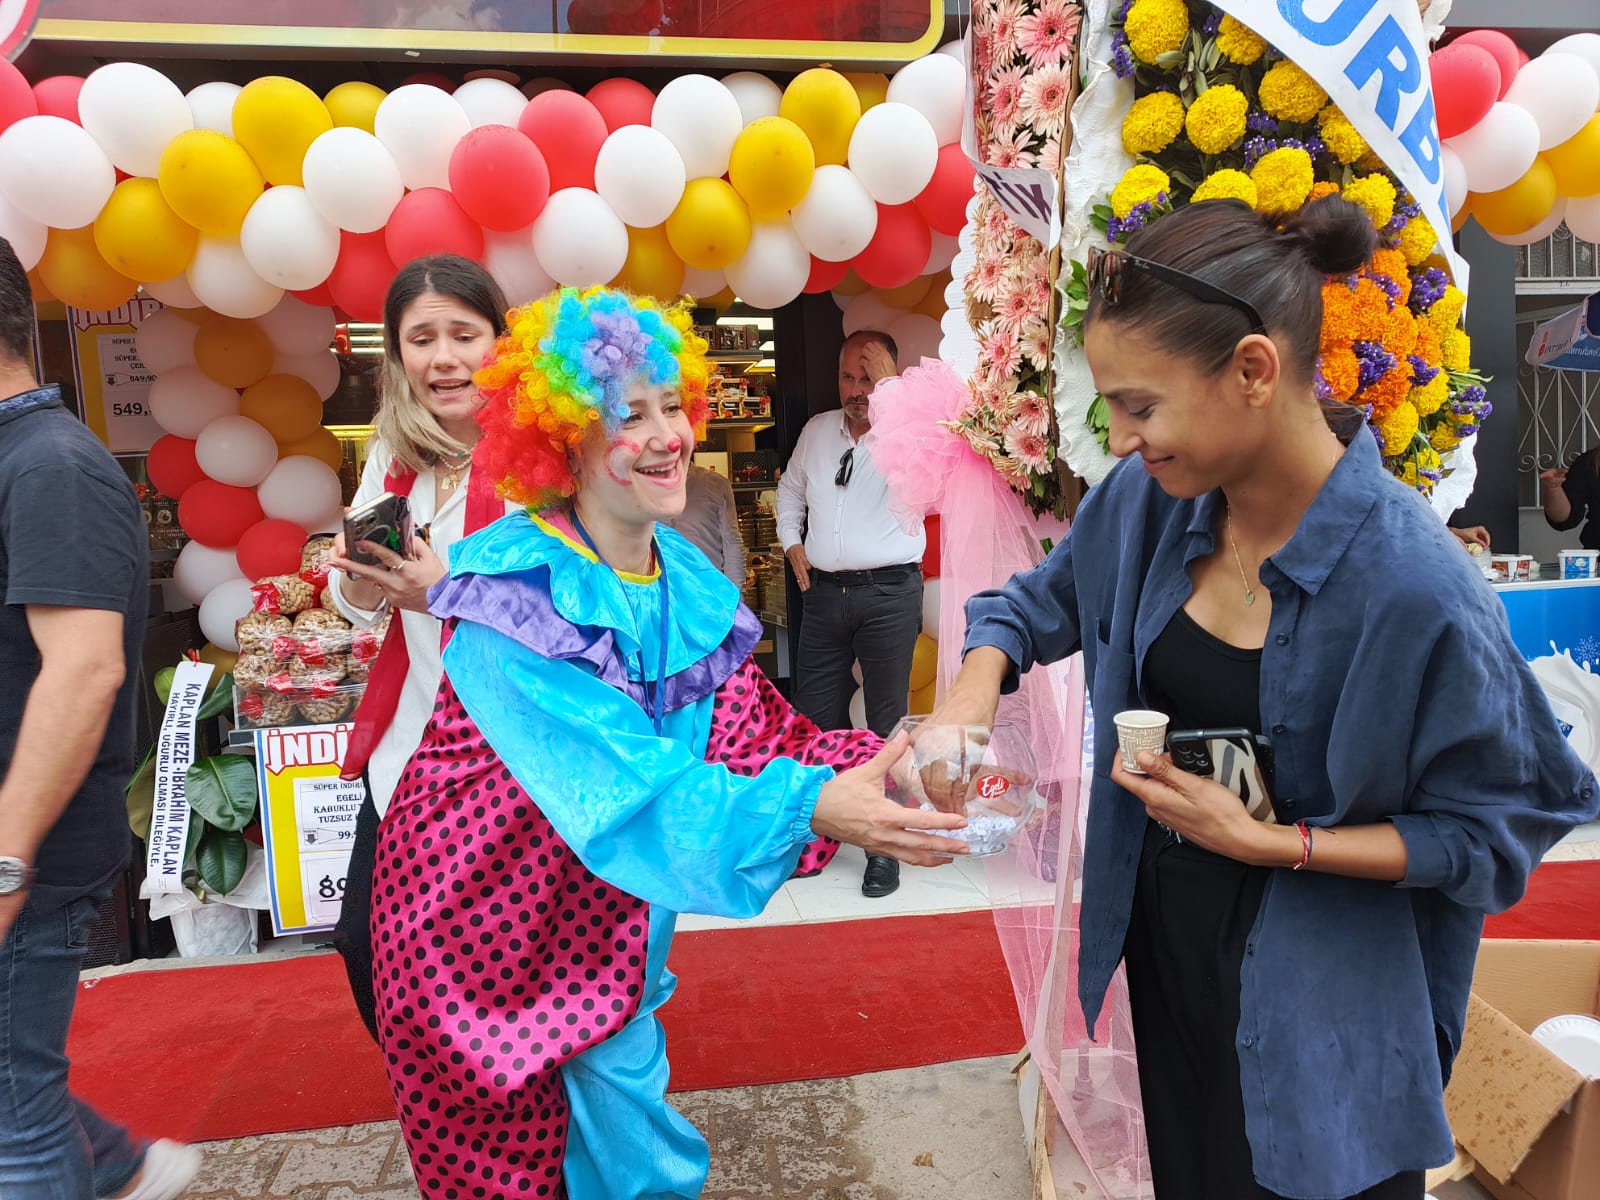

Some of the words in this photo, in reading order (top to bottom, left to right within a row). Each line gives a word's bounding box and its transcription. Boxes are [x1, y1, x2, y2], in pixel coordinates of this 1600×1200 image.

[1277, 0, 1446, 186] URB
[113, 402, 152, 417] 549,
[175, 683, 202, 728] KAPLAN
[159, 734, 173, 773] UĞURLU
[173, 732, 190, 764] MEZE
[265, 723, 352, 776] İNDİ
[156, 776, 168, 811] OLMASI
[313, 783, 338, 791] SÜPER
[336, 792, 362, 802] EGELİ
[313, 804, 357, 814] KABUKLU
[317, 814, 353, 824] TUZSUZ
[162, 826, 183, 875] KAPLAN
